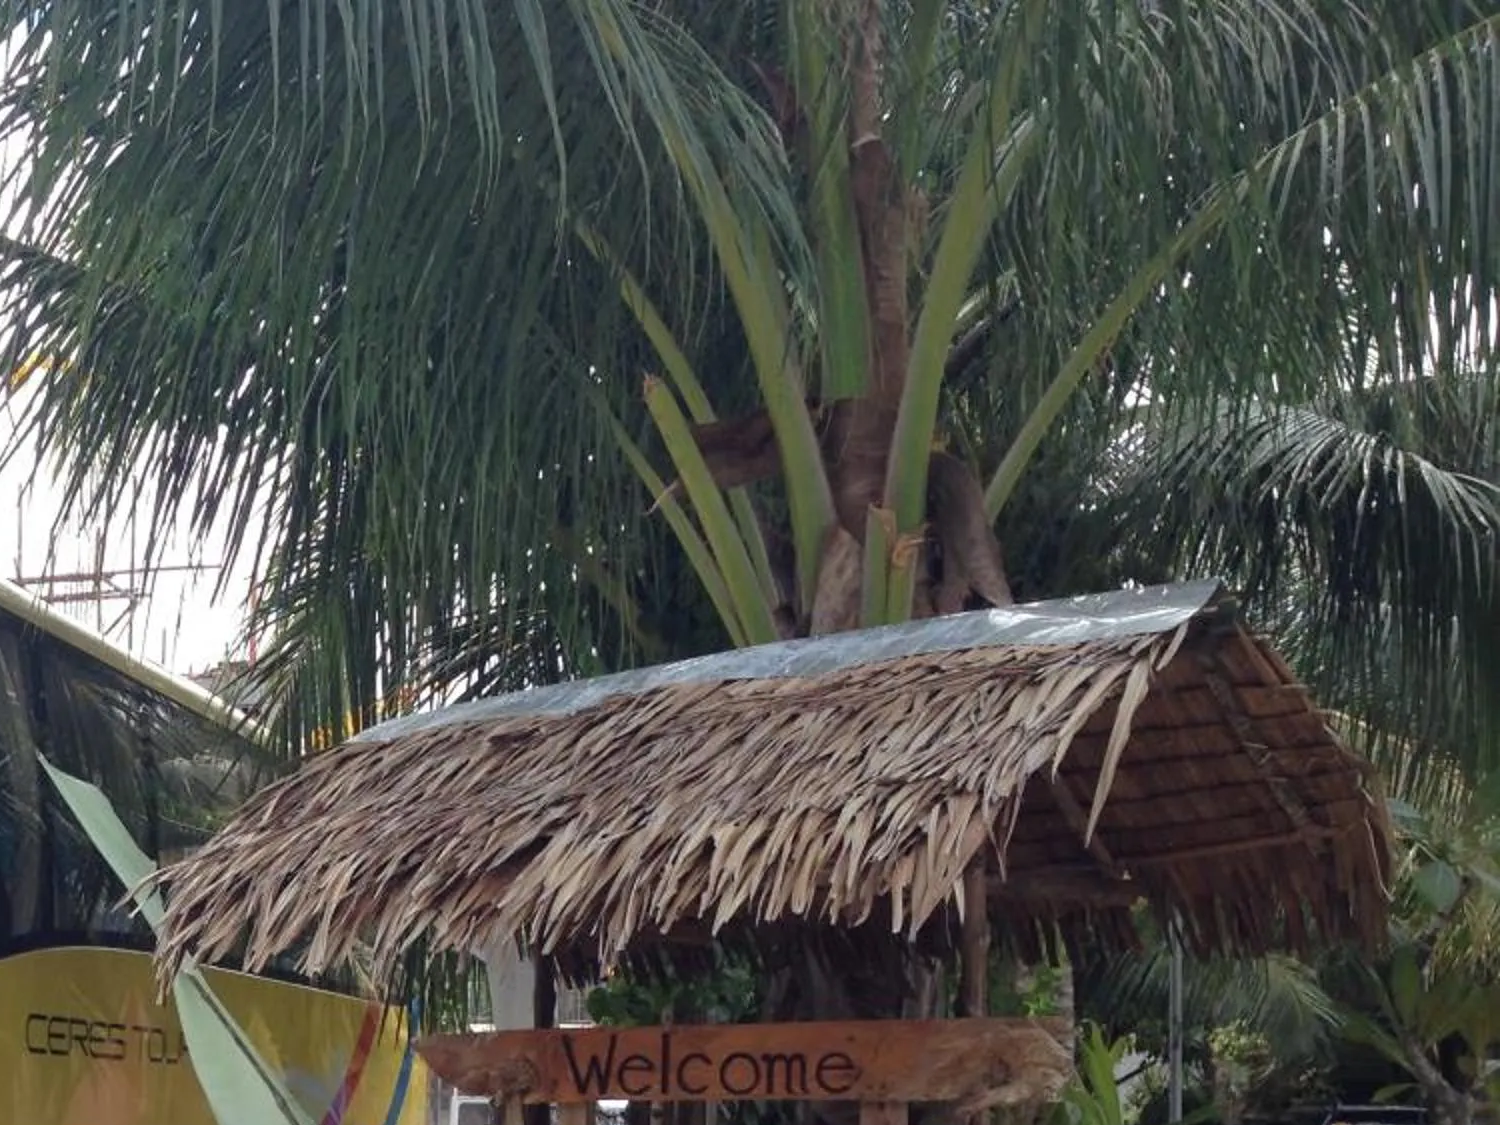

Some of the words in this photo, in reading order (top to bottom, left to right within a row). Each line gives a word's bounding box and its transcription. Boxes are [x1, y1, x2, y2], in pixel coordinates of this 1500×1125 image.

[26, 1013, 127, 1061] CERES
[132, 1025, 188, 1064] TOU
[563, 1034, 858, 1096] Welcome
